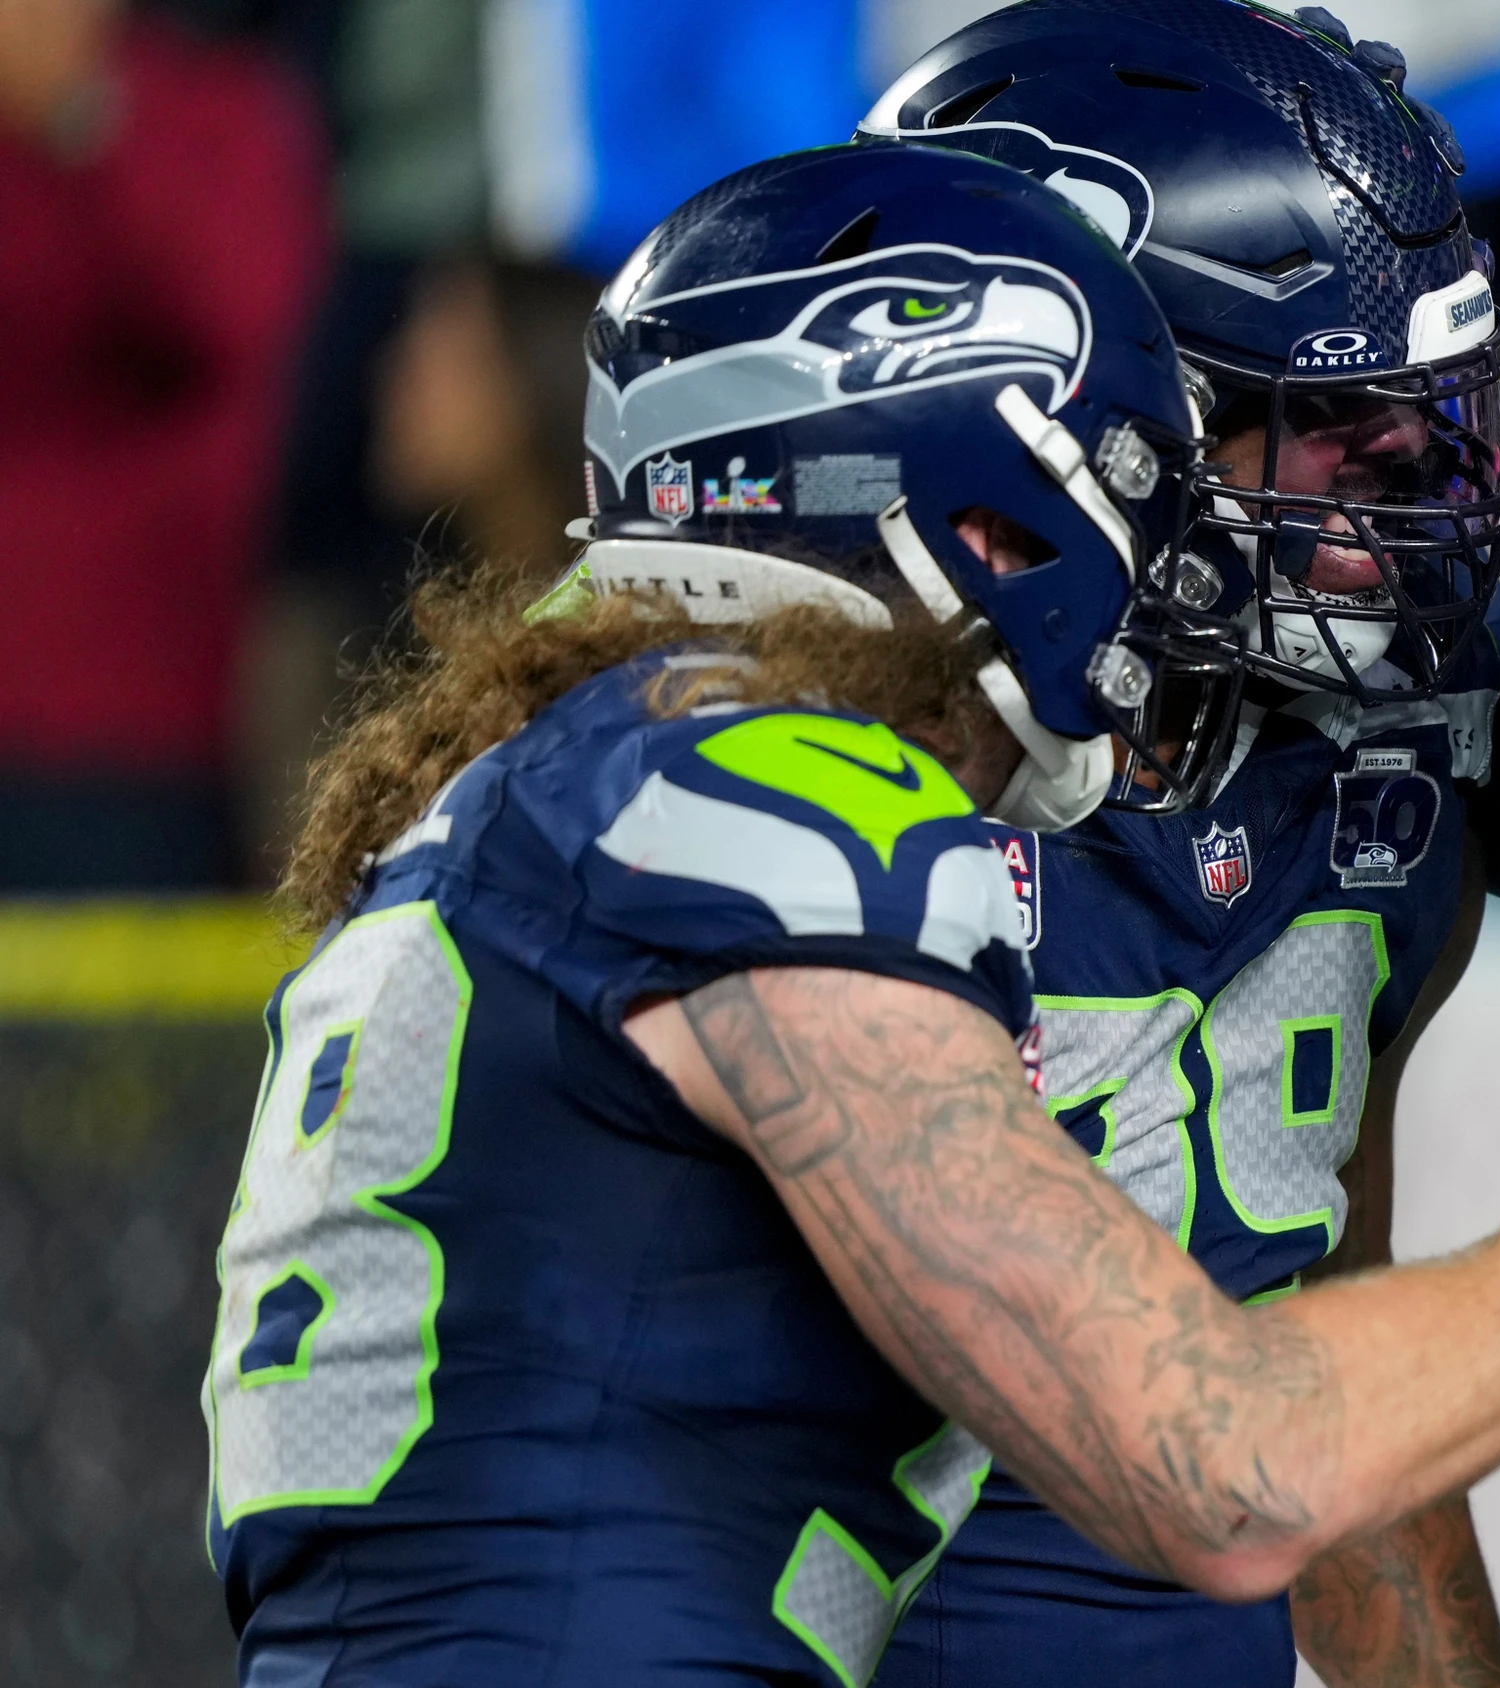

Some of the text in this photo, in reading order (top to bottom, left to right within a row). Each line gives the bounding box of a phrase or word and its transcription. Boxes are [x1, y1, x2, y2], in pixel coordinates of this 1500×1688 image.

[1450, 289, 1494, 329] SEAHAWKS
[1296, 352, 1381, 367] OAKLEY
[654, 486, 688, 514] NFL
[1365, 758, 1403, 767] EST 1976
[1333, 775, 1437, 869] 50
[1207, 859, 1245, 894] NFL
